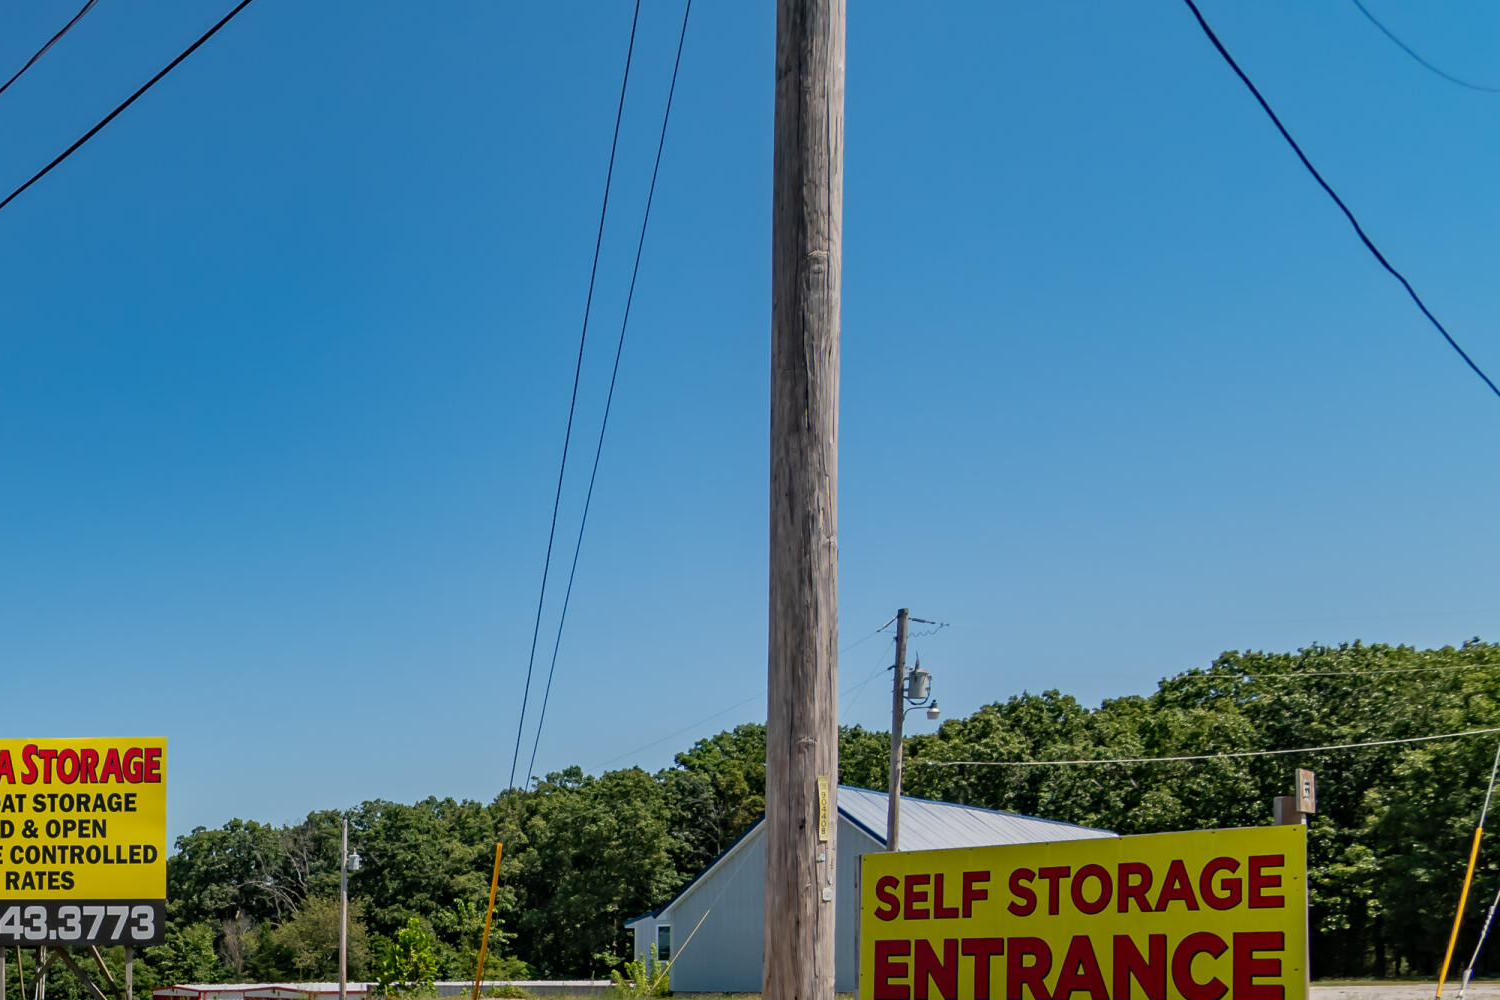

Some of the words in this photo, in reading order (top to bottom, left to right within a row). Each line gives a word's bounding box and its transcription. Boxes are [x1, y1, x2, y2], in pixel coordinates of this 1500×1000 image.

[21, 744, 162, 785] STORAGE
[32, 792, 137, 813] STORAGE
[21, 819, 39, 839] &
[45, 818, 107, 838] OPEN
[9, 844, 158, 865] CONTROLLED
[5, 871, 75, 891] RATES
[874, 870, 991, 921] SELF
[1007, 854, 1285, 917] STORAGE
